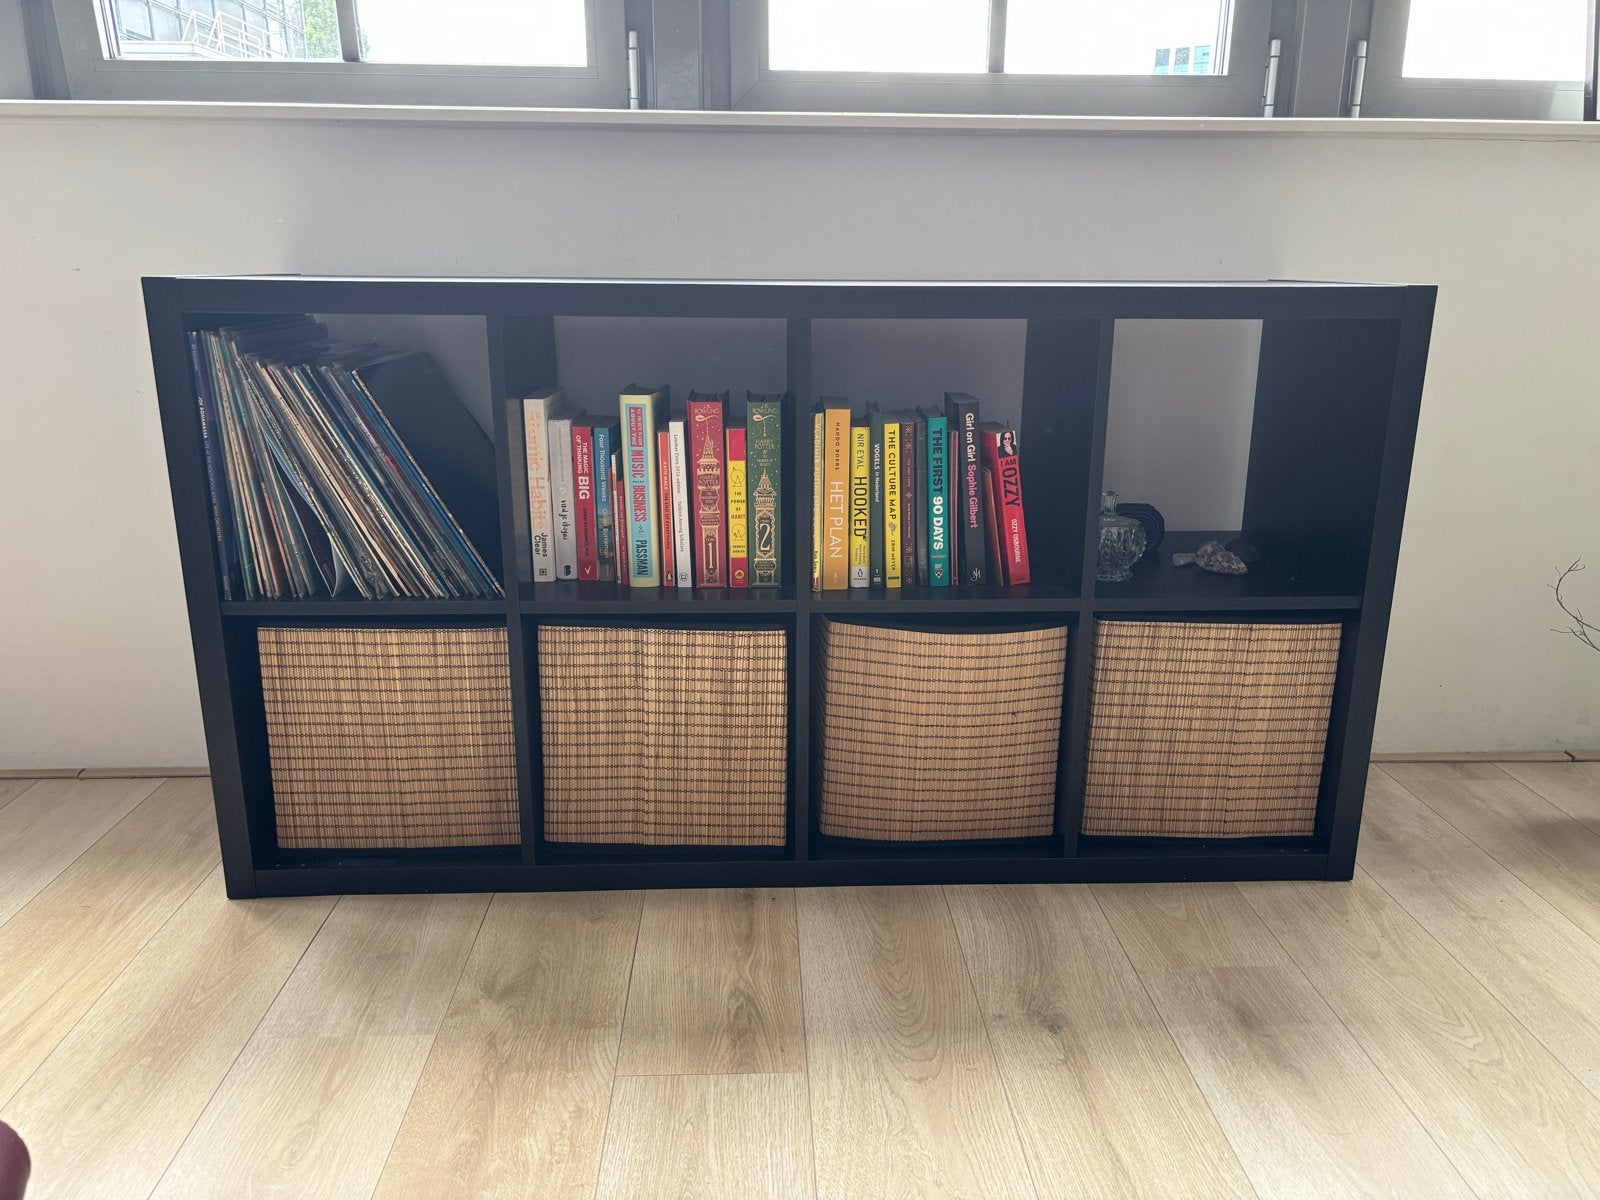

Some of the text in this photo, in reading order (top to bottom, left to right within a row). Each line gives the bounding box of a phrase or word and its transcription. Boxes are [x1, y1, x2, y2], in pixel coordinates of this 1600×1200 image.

[198, 407, 208, 438] BONAMASSA
[888, 430, 896, 449] THE
[576, 435, 584, 474] OF THINKING
[932, 428, 942, 454] THE
[631, 450, 644, 478] MUSIC
[856, 450, 864, 469] EYAL
[888, 452, 896, 496] CULTURE
[932, 458, 942, 494] FIRST
[966, 412, 978, 528] Girl on Girl Sophie Gilbert
[530, 476, 546, 529] Habits
[578, 476, 590, 500] BIG
[633, 485, 647, 522] BUSINESS
[1002, 467, 1020, 507] OZZY
[830, 481, 844, 558] HET PLAN
[854, 476, 868, 537] HOOKED
[933, 496, 944, 514] 90
[534, 535, 542, 556] Clear
[759, 523, 770, 550] 2
[933, 517, 944, 550] DAYS
[1010, 518, 1021, 564] OZZY OSBOURNE
[635, 540, 648, 576] PASSMAN
[708, 542, 714, 569] 1
